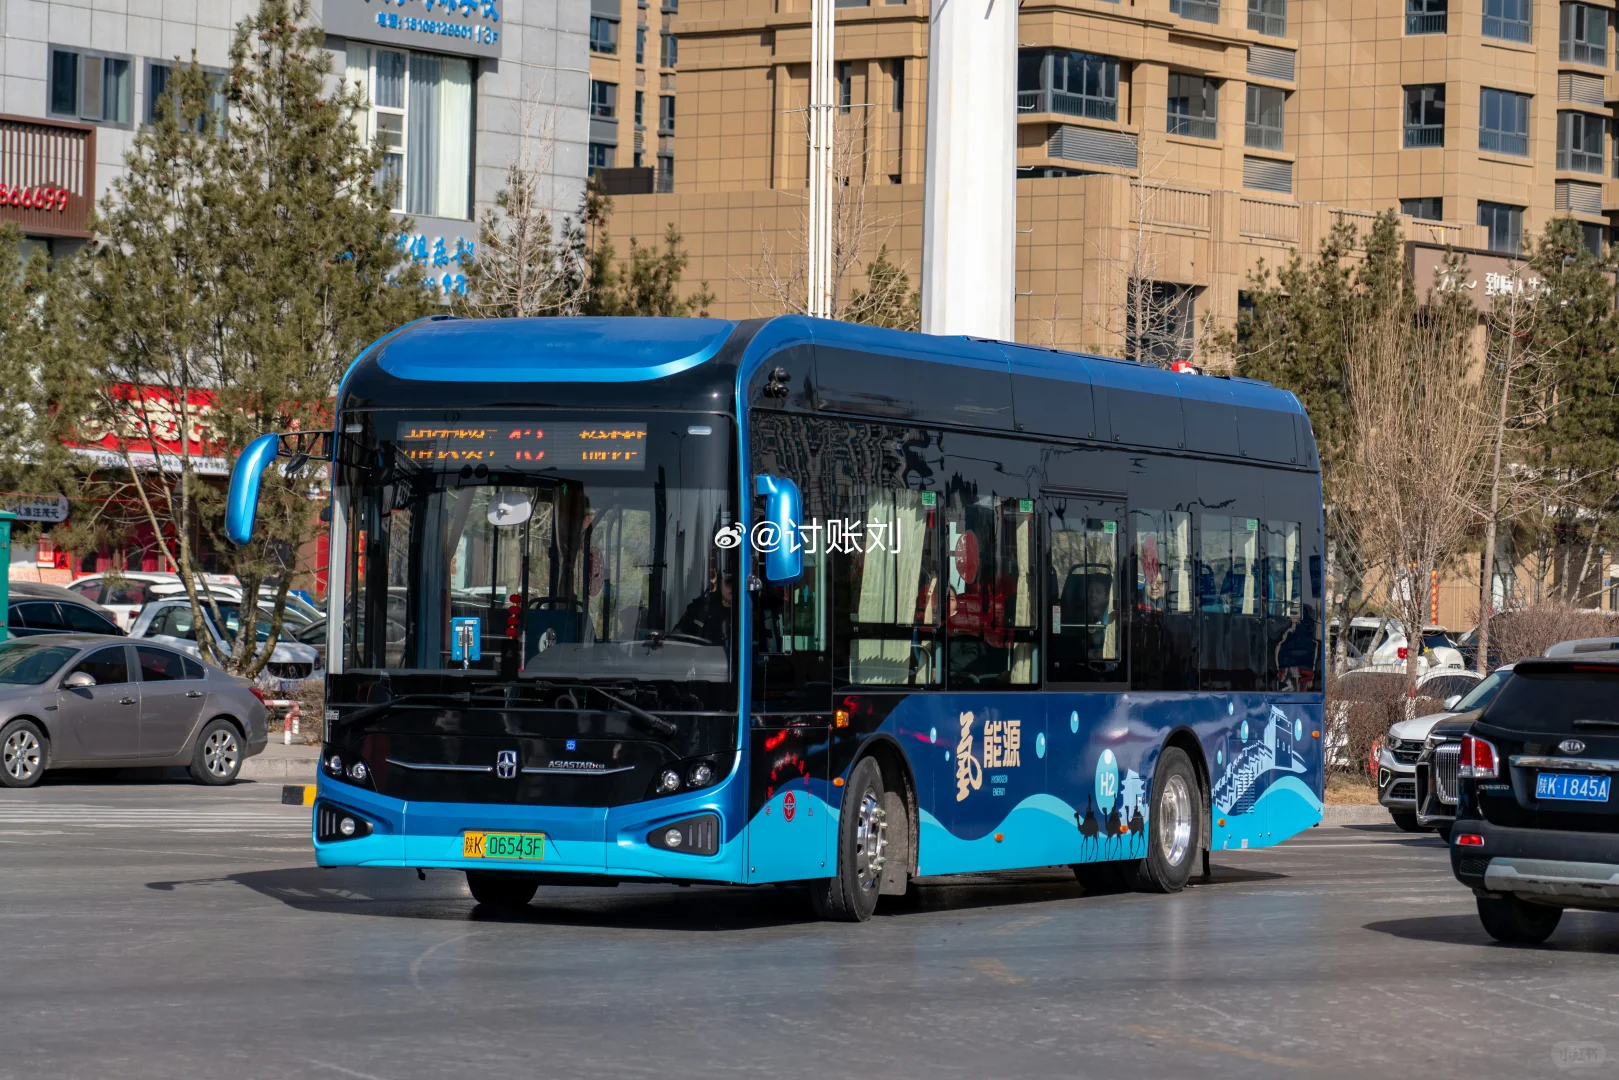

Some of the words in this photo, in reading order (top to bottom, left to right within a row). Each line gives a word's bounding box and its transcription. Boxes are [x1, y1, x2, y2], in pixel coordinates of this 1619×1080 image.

[1564, 741, 1581, 751] KIA
[548, 761, 593, 769] ASIASTAR
[1101, 772, 1115, 796] H2
